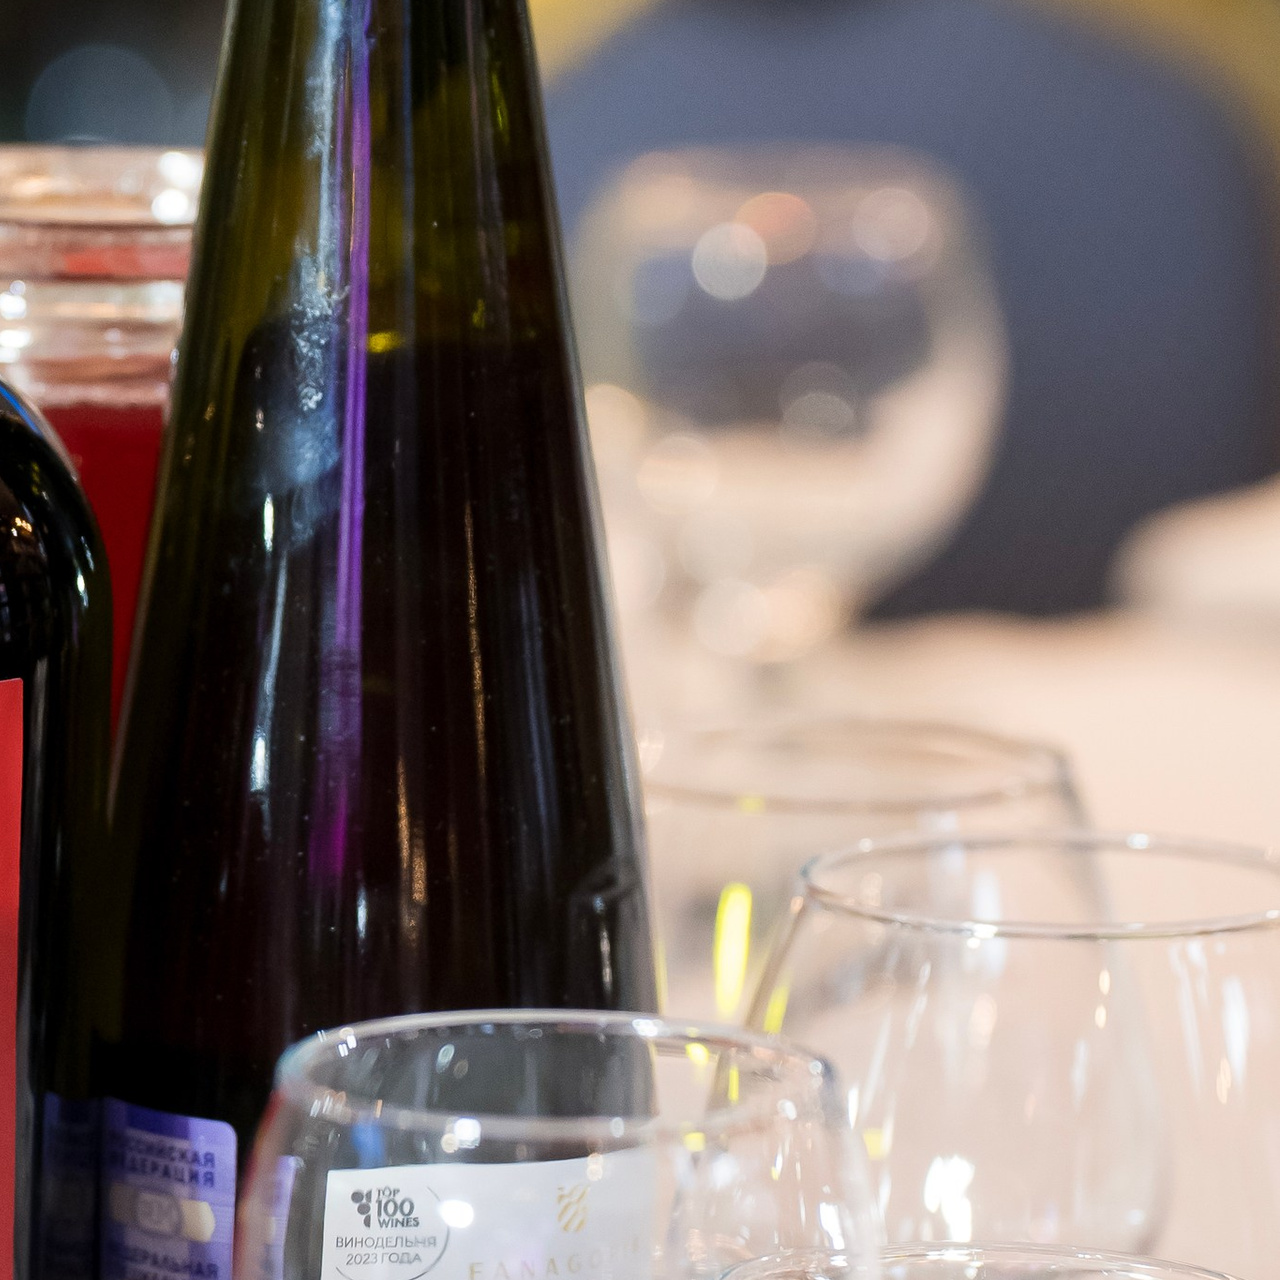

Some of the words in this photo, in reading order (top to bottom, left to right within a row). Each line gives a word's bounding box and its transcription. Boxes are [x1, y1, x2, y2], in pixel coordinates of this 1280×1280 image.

[376, 1198, 415, 1217] 100
[378, 1217, 420, 1228] WINES
[336, 1236, 437, 1250] ВИНОДЕЛЬНЯ
[346, 1253, 378, 1266] 2023
[381, 1252, 423, 1265] ГОДА
